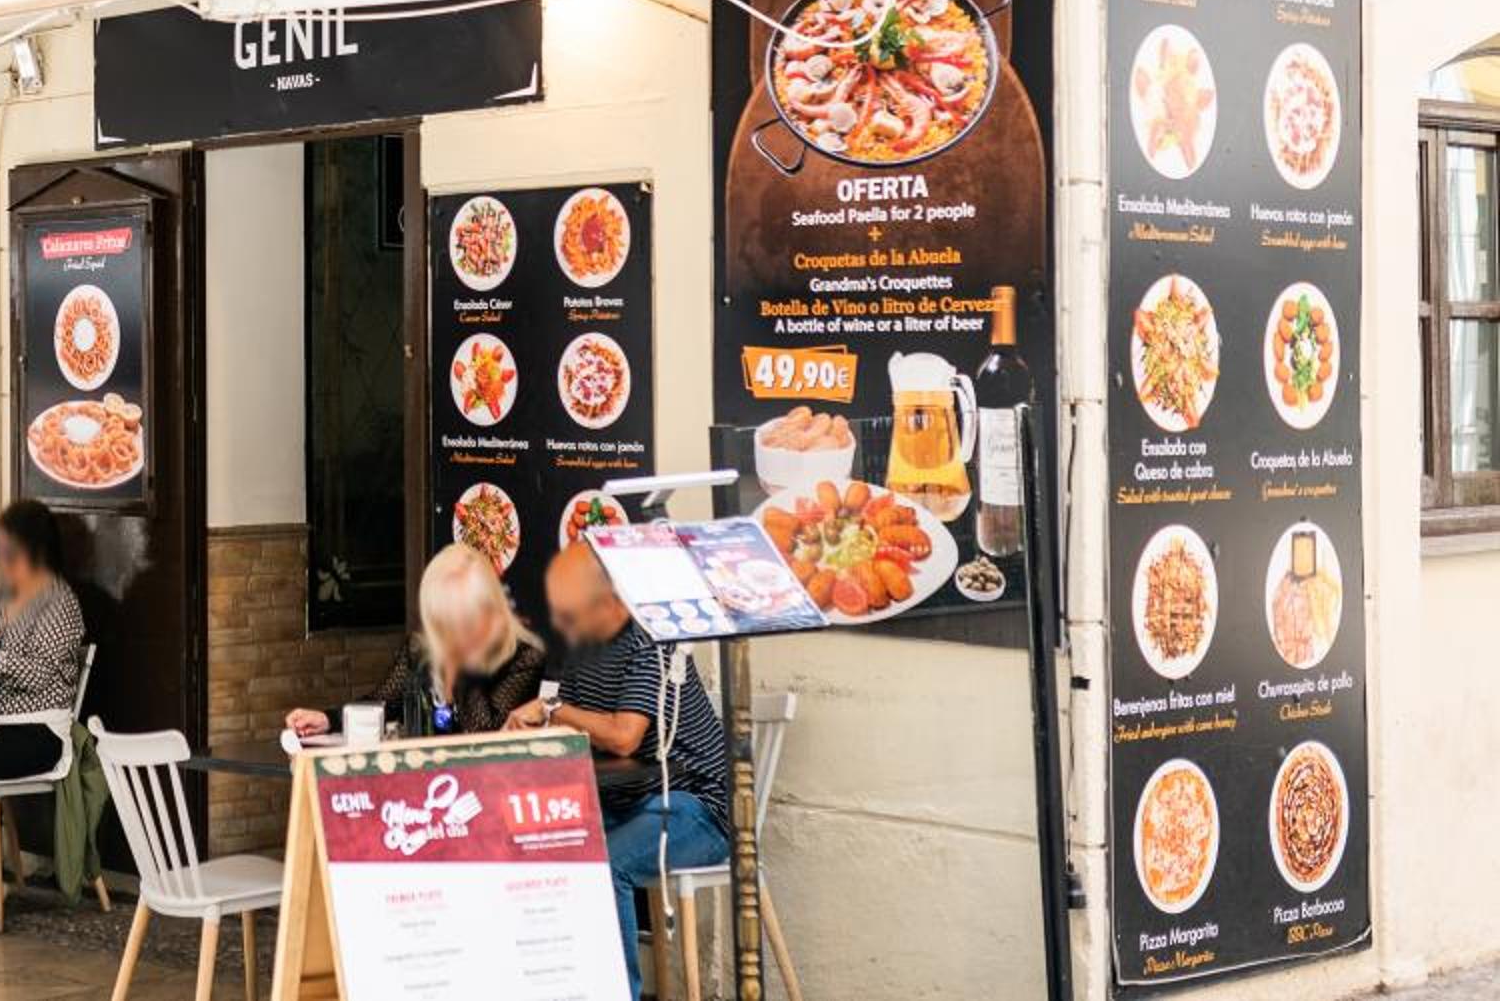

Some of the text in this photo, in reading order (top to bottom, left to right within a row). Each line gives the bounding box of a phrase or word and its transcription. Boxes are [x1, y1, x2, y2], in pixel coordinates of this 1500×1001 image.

[234, 8, 358, 69] GENIL
[836, 175, 929, 202] OFERTA
[792, 202, 976, 226] Seafood Paella for 2 people
[1118, 194, 1164, 214] Ensalada
[1251, 203, 1284, 221] Huevos
[1285, 207, 1307, 223] rotos
[1310, 212, 1325, 223] con
[794, 247, 962, 271] Croquetas de la Abuela
[809, 275, 953, 293] Grandma's Croquettes
[453, 297, 513, 310] Ensalada César
[563, 296, 624, 308] Patatas Bravas
[761, 300, 808, 317] Botella
[812, 299, 829, 315] de
[831, 299, 866, 315] Vino
[870, 302, 878, 314] o
[882, 298, 915, 314] litro
[917, 297, 937, 313] de
[775, 315, 984, 333] A bottle of wine or a liter of beer
[755, 355, 850, 391] 49,90€
[442, 435, 476, 448] Ensalada
[546, 439, 645, 454] Huevos rotos con jamón
[1141, 438, 1207, 456] Ensalada con
[1134, 460, 1214, 480] Queso de cabra
[1251, 447, 1353, 473] Croquetas de la Abuela
[1317, 673, 1329, 691] de
[1331, 671, 1353, 695] pollo
[1114, 683, 1235, 718] Berenjenas fritas con miel
[508, 791, 581, 823] 11,95€
[1273, 898, 1345, 924] Pizza Barbacoa
[1139, 922, 1219, 951] Pizza Margarita
